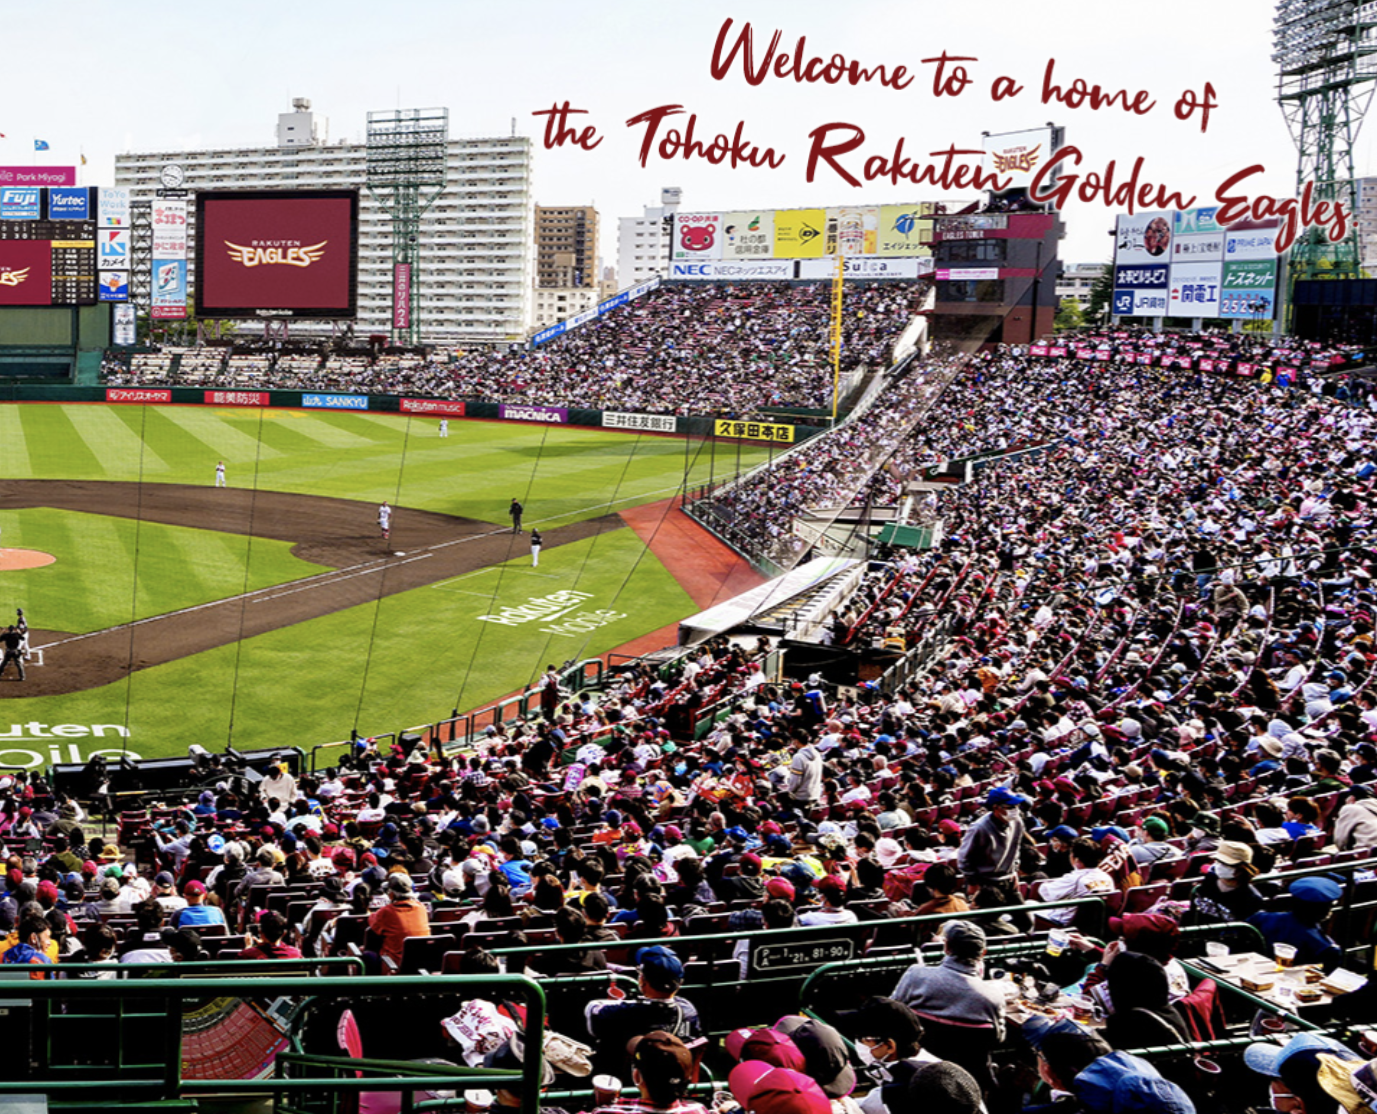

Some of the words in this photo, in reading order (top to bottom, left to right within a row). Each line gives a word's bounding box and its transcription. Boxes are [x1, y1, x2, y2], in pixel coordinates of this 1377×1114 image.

[16, 173, 35, 181] Park
[37, 173, 66, 183] Miyagi
[2, 190, 37, 205] Fuji
[52, 193, 85, 205] Yurtec
[942, 231, 965, 240] EAGLES
[966, 230, 984, 239] TOWER
[101, 258, 126, 267] カメイ
[241, 247, 312, 268] EAGLES
[674, 264, 711, 275] NEC
[842, 261, 888, 272] Suica
[1224, 271, 1274, 286] トスネット
[397, 265, 406, 327] 三井のリハウス
[1181, 284, 1218, 303] 関電工
[1116, 295, 1131, 307] JR
[326, 396, 368, 408] SANKYU
[403, 400, 437, 412] Rakuten
[438, 402, 461, 412] music
[604, 413, 674, 431] 三井住友銀行
[720, 421, 790, 440] 久保田本店
[476, 589, 595, 627] Rakuten
